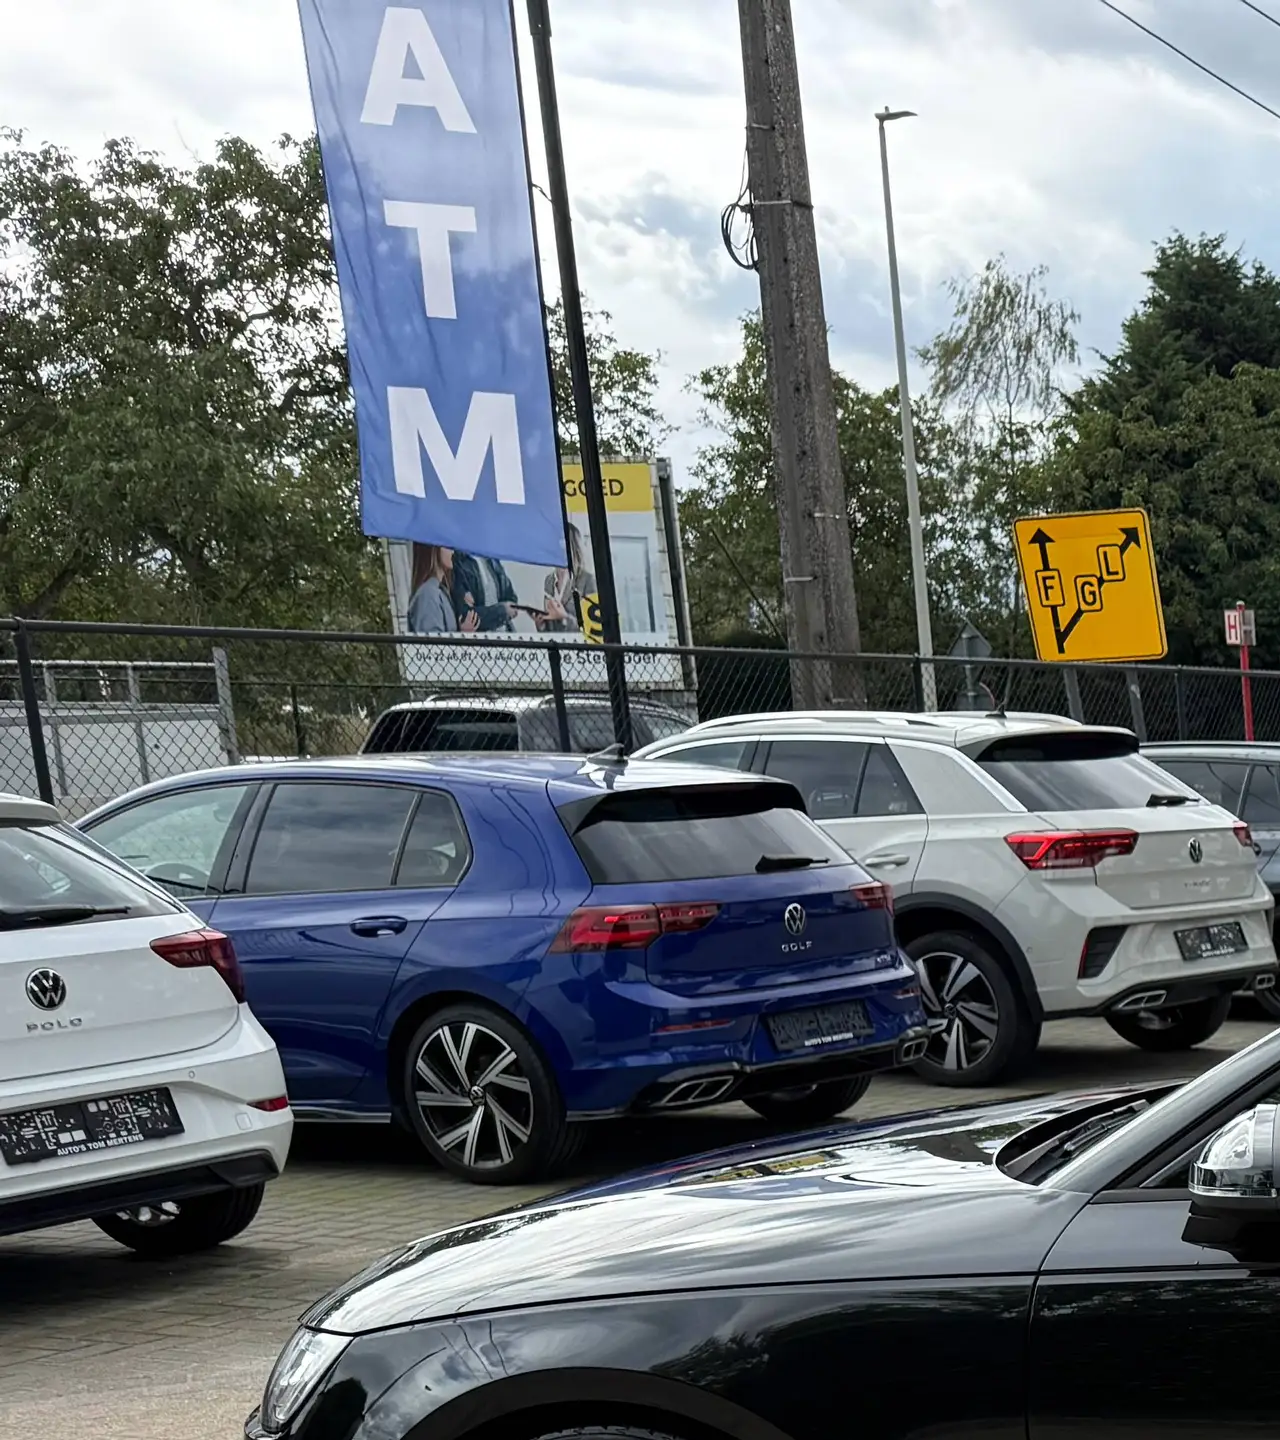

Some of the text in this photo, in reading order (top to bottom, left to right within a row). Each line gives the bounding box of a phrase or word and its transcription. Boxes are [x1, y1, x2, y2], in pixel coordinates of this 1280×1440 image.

[360, 6, 526, 506] ATM
[1102, 550, 1119, 576] L
[1041, 575, 1056, 601] F
[1080, 580, 1097, 607] G
[1227, 614, 1239, 644] H
[781, 940, 813, 952] GOLF
[26, 1017, 83, 1033] POLO
[57, 1133, 145, 1156] AUTO'S TOM MERTENS
